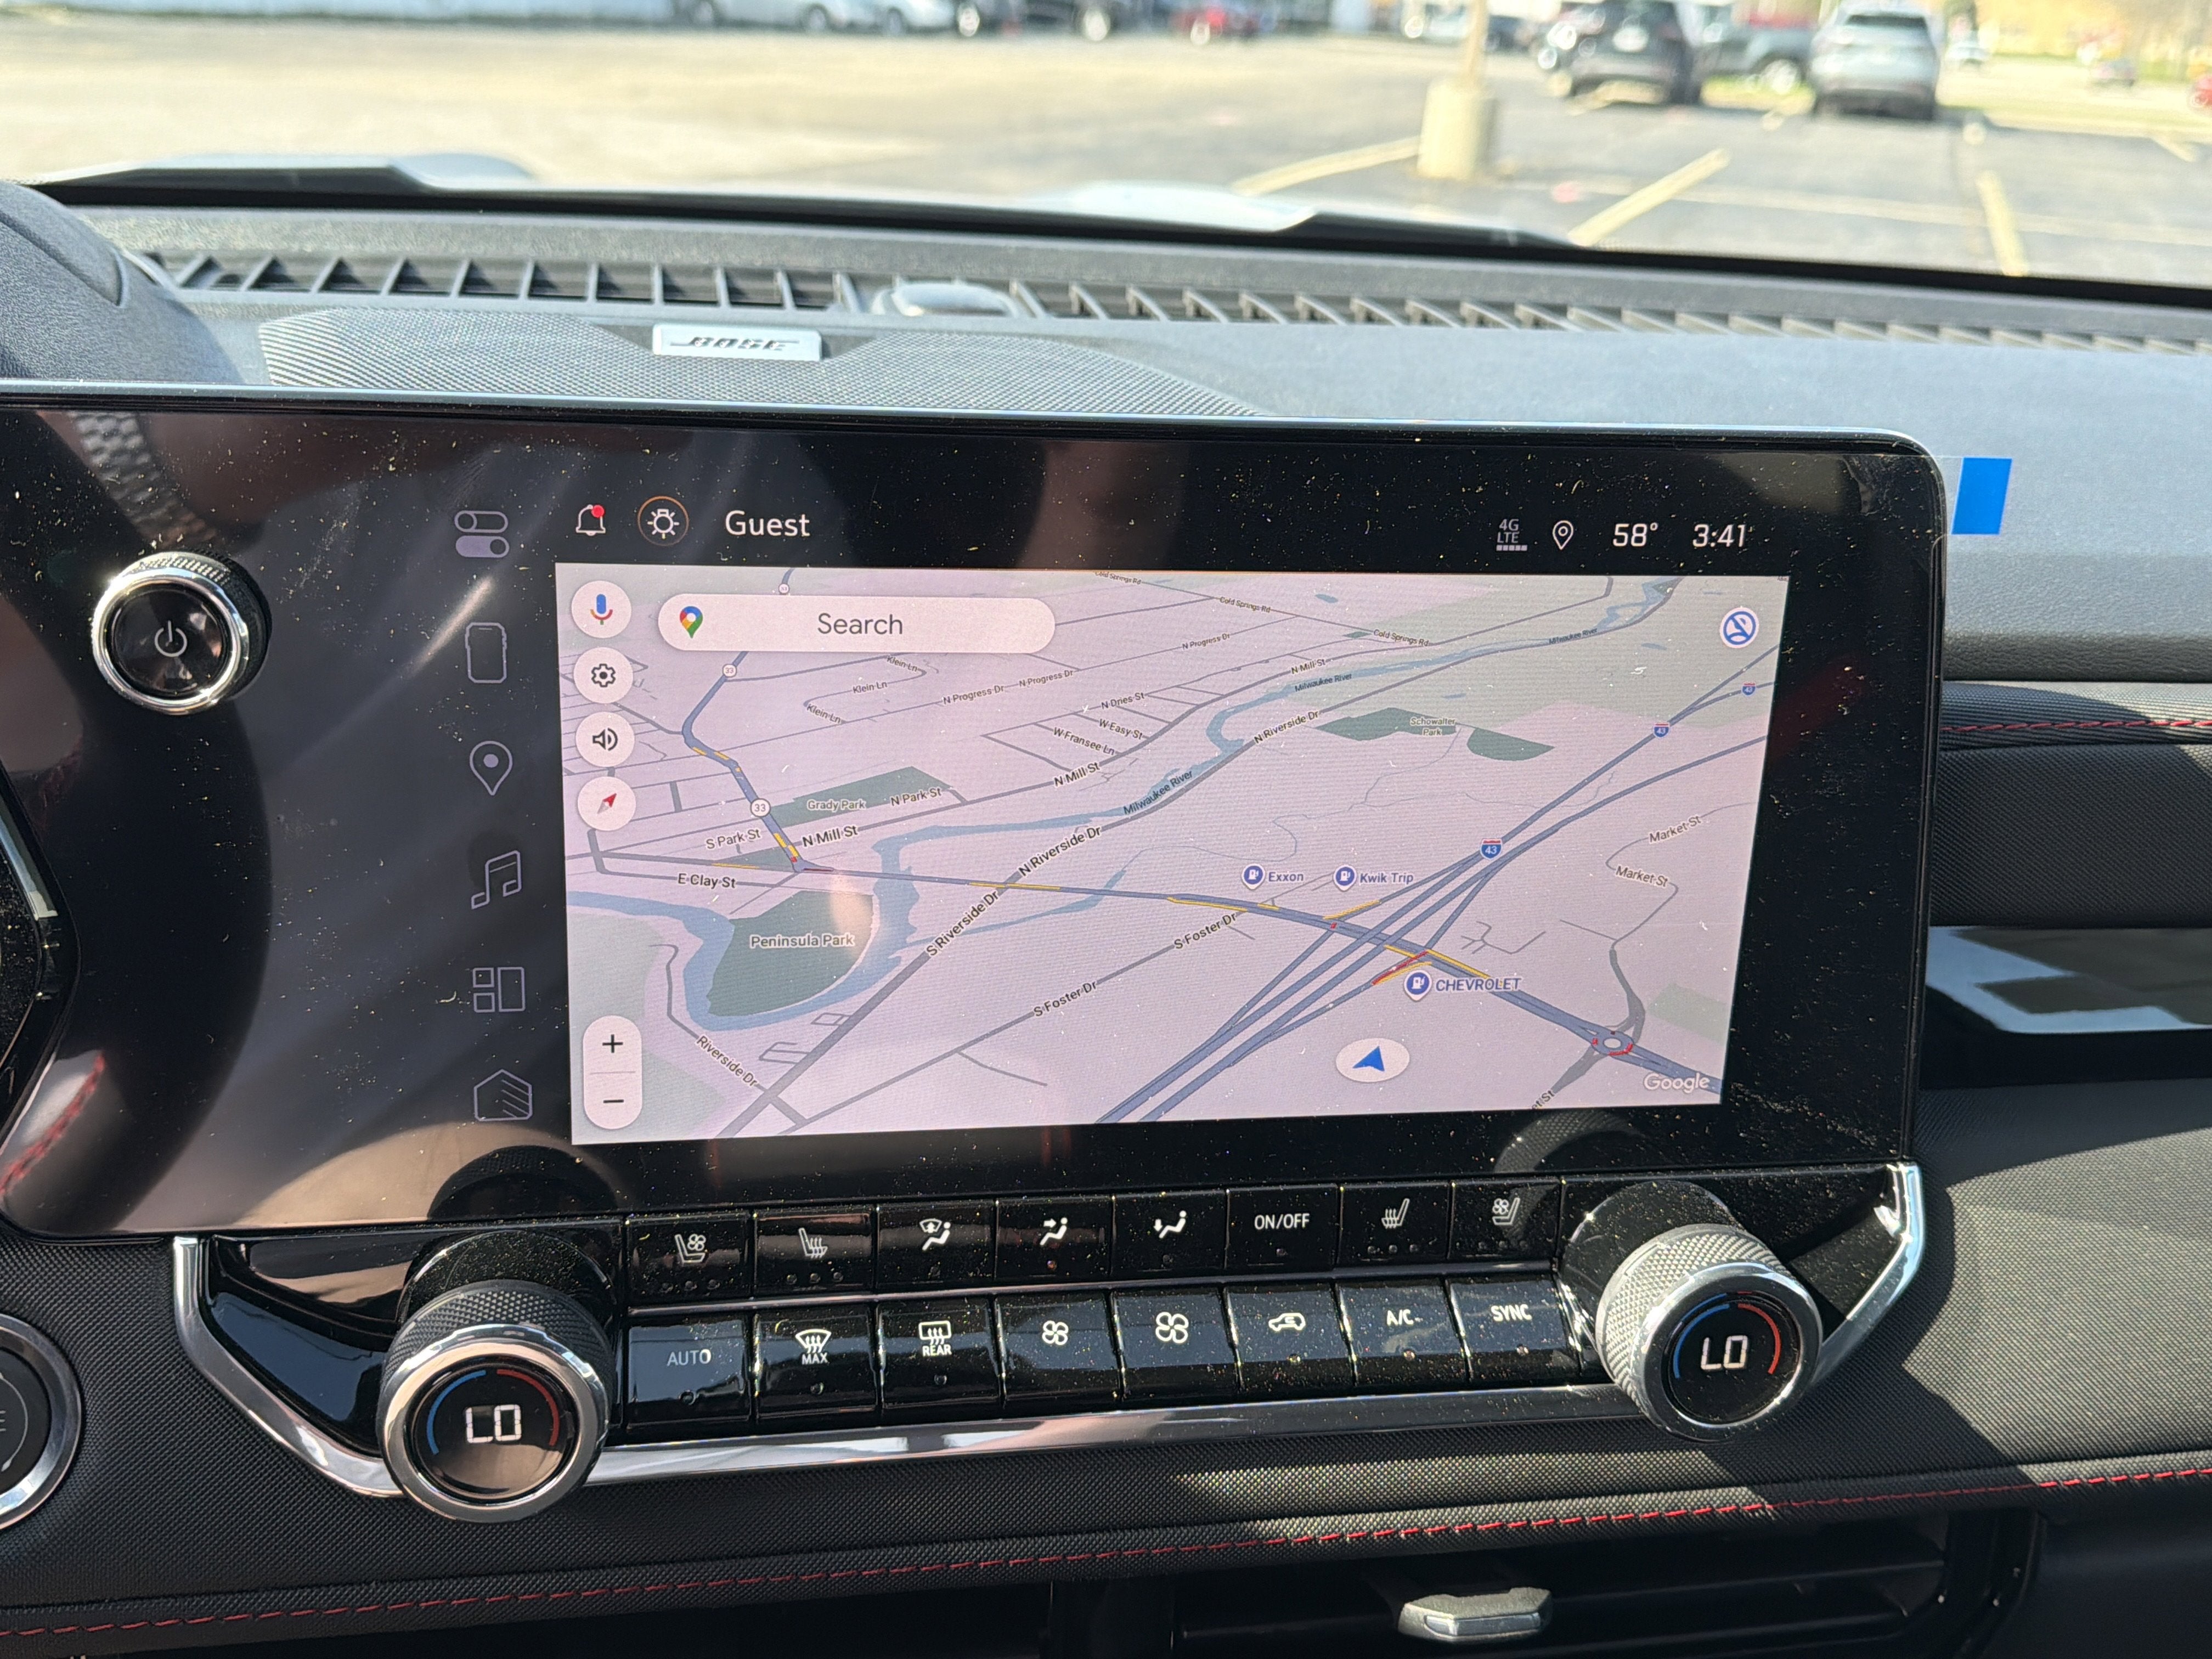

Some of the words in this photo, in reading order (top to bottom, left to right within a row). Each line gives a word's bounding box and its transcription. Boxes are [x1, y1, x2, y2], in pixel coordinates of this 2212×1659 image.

[670, 336, 800, 351] BOSE
[725, 510, 810, 537] Guest
[1499, 520, 1519, 531] 4G
[1497, 533, 1519, 543] LTE
[1613, 522, 1658, 546] 58°
[1692, 524, 1747, 547] 3:41
[1220, 596, 1235, 605] Cold
[1237, 599, 1263, 611] Springs
[817, 613, 903, 635] Search
[1190, 635, 1221, 648] Progress
[1373, 629, 1391, 637] Cold
[1392, 631, 1418, 644] Springs
[887, 656, 906, 669] Klein
[907, 663, 918, 672] Ln
[1300, 661, 1316, 672] Mill
[1316, 659, 1325, 667] St
[853, 682, 874, 693] Klein
[876, 680, 887, 690] Ln
[1028, 673, 1062, 687] Progress
[1064, 669, 1074, 678] Dr
[1295, 677, 1331, 692] Milwaukee
[1333, 674, 1352, 682] River
[944, 696, 951, 704] N
[952, 689, 991, 703] Progress
[991, 684, 1005, 693] Dr
[1102, 701, 1108, 709] N
[1110, 696, 1131, 708] Dries
[1133, 692, 1144, 701] St
[806, 704, 827, 719] Klein
[829, 714, 841, 724] Ln
[1410, 717, 1455, 725] Schowalter
[1099, 718, 1109, 727] W
[1109, 722, 1132, 738] Easy
[1133, 730, 1143, 739] St
[1254, 735, 1263, 743] N
[1263, 717, 1307, 738] Riverside
[1307, 710, 1319, 721] Dr
[1423, 727, 1442, 736] Park
[1053, 727, 1064, 737] W
[1065, 731, 1102, 752] Fransee
[1102, 744, 1115, 755] Ln
[1054, 776, 1065, 786] N
[1066, 769, 1084, 782] Mill
[1086, 761, 1099, 774] St
[890, 795, 899, 805] N
[900, 791, 926, 804] Park
[927, 787, 941, 798] St
[1124, 786, 1170, 814] Milwaukee
[1170, 771, 1193, 788] River
[754, 803, 766, 812] 33
[808, 800, 838, 811] Grady
[842, 800, 866, 809] Park
[803, 835, 812, 846] N
[815, 828, 840, 844] Mill
[843, 825, 857, 837] St
[1649, 822, 1688, 842] Market
[1689, 816, 1701, 826] St
[706, 839, 714, 849] S
[717, 834, 744, 848] Park
[746, 829, 761, 839] St
[1019, 863, 1031, 876] N
[1031, 834, 1085, 868] Riverside
[1087, 825, 1101, 839] Dr
[678, 873, 686, 884] E
[690, 873, 718, 889] Clay
[720, 877, 736, 888] St
[1268, 872, 1304, 882] Exxon
[1361, 873, 1387, 882] Kwik
[1390, 873, 1413, 884] Trip
[1616, 865, 1654, 883] Market
[1656, 876, 1668, 887] St
[927, 944, 938, 957] S
[937, 902, 986, 949] Riverside
[984, 891, 999, 906] Dr
[1174, 938, 1183, 950] S
[1184, 921, 1221, 945] Foster
[1222, 912, 1237, 926] Dr
[751, 935, 820, 947] Peninsula
[823, 935, 854, 946] Park
[1436, 978, 1520, 991] CHEVROLET
[1034, 1006, 1043, 1017] S
[1044, 988, 1082, 1012] Foster
[1083, 981, 1097, 994] Dr
[697, 1036, 743, 1077] Riverside
[743, 1073, 758, 1086] Dr
[1645, 1074, 1709, 1093] Google
[1542, 1091, 1555, 1102] St
[1254, 1213, 1310, 1231] ON/OFF
[1386, 1309, 1414, 1326] A/C
[1491, 1302, 1531, 1322] SYNC
[667, 1348, 712, 1367] AUTO
[801, 1352, 828, 1365] MAX
[922, 1344, 952, 1357] REAR
[1701, 1335, 1748, 1370] LO
[465, 1404, 522, 1443] LO
